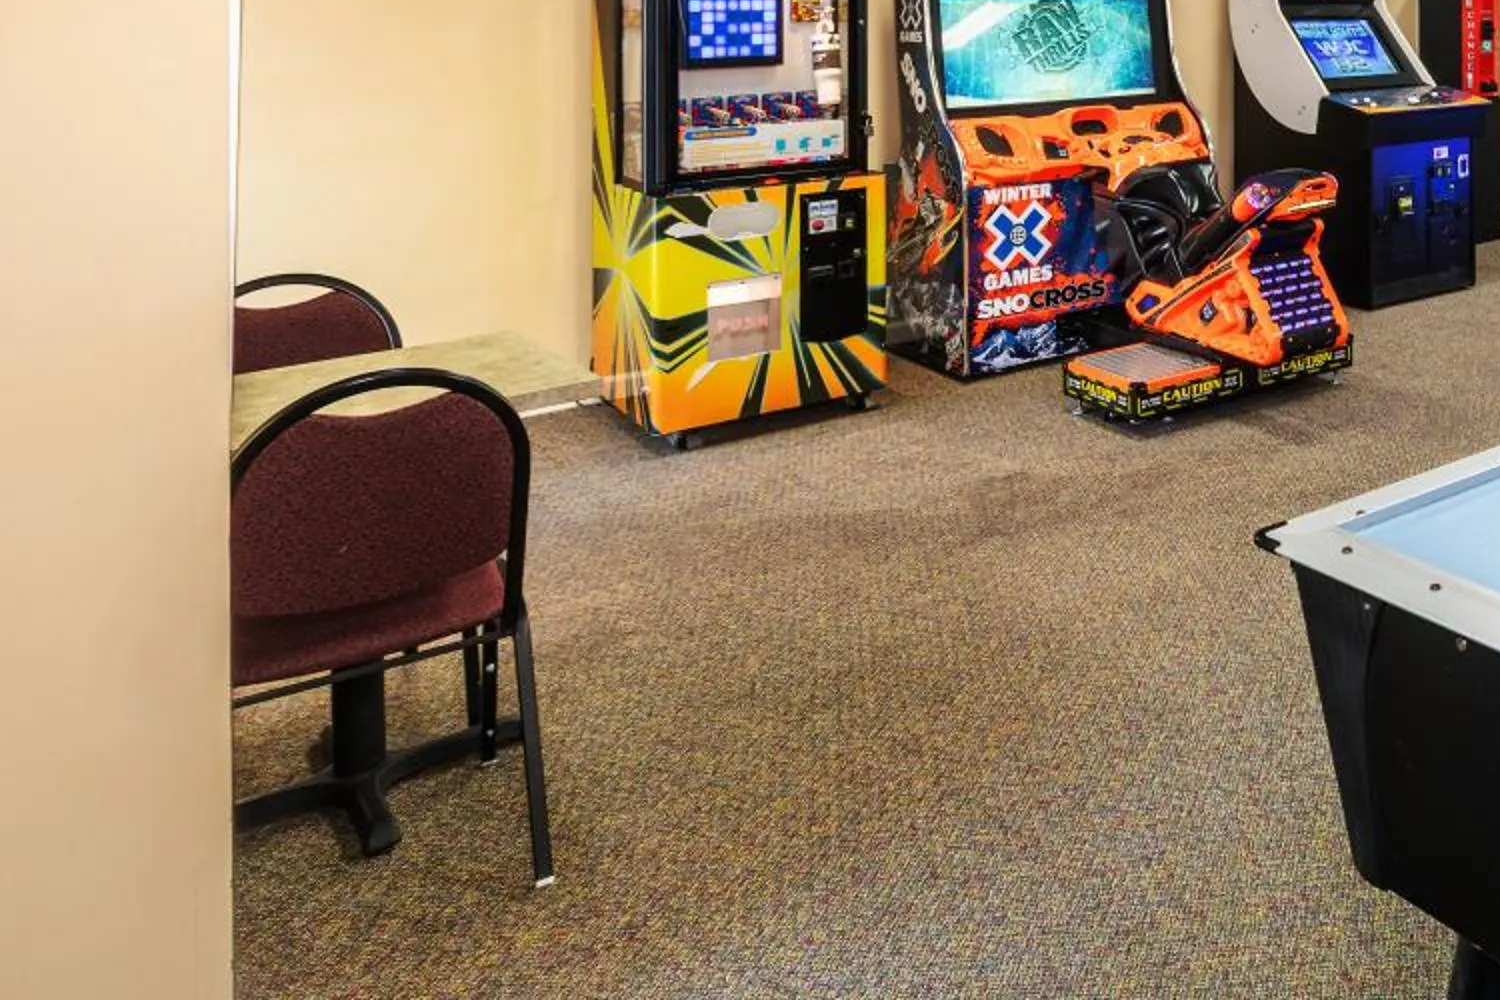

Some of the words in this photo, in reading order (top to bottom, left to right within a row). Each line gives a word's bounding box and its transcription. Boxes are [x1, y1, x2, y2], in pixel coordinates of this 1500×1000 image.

[983, 182, 1053, 205] WINTER
[983, 264, 1054, 291] GAMES
[977, 279, 1106, 320] SNOCROSS
[1162, 379, 1221, 403] CAUTION
